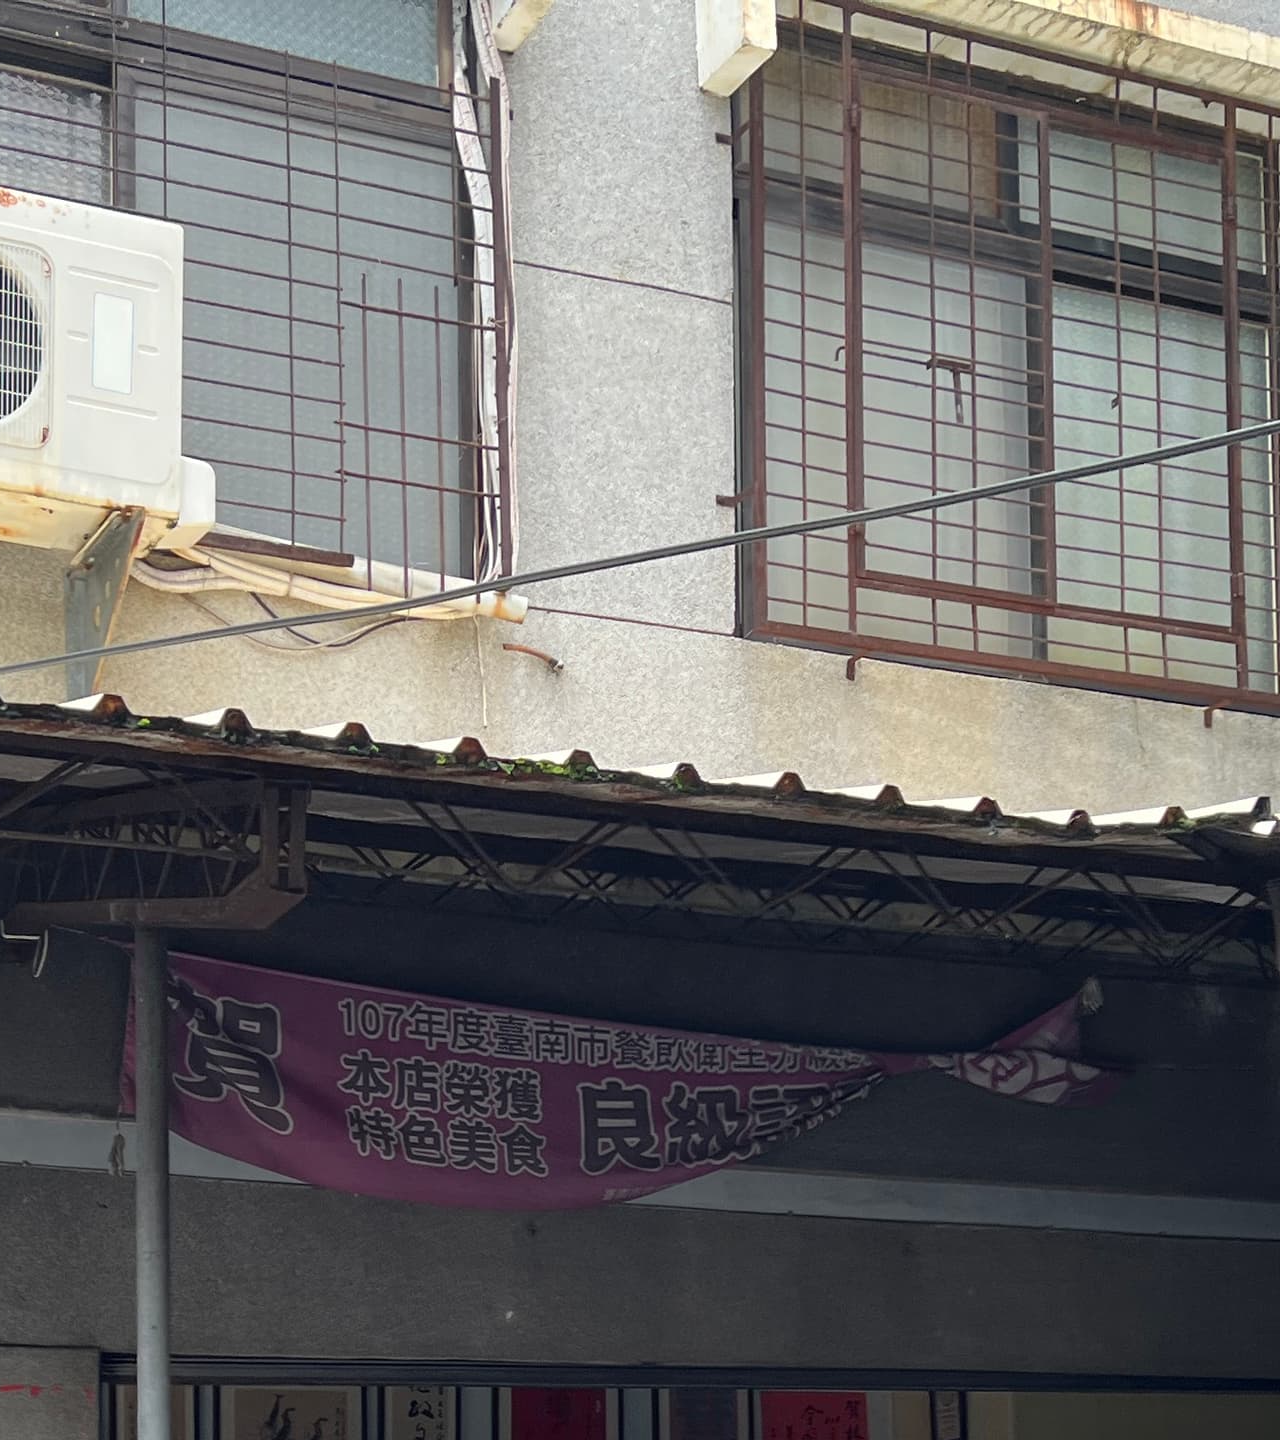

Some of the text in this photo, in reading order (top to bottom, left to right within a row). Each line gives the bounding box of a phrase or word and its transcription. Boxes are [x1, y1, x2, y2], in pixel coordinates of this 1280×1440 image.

[337, 1050, 544, 1122] 本店榮獲
[345, 1107, 550, 1178] 特色美食
